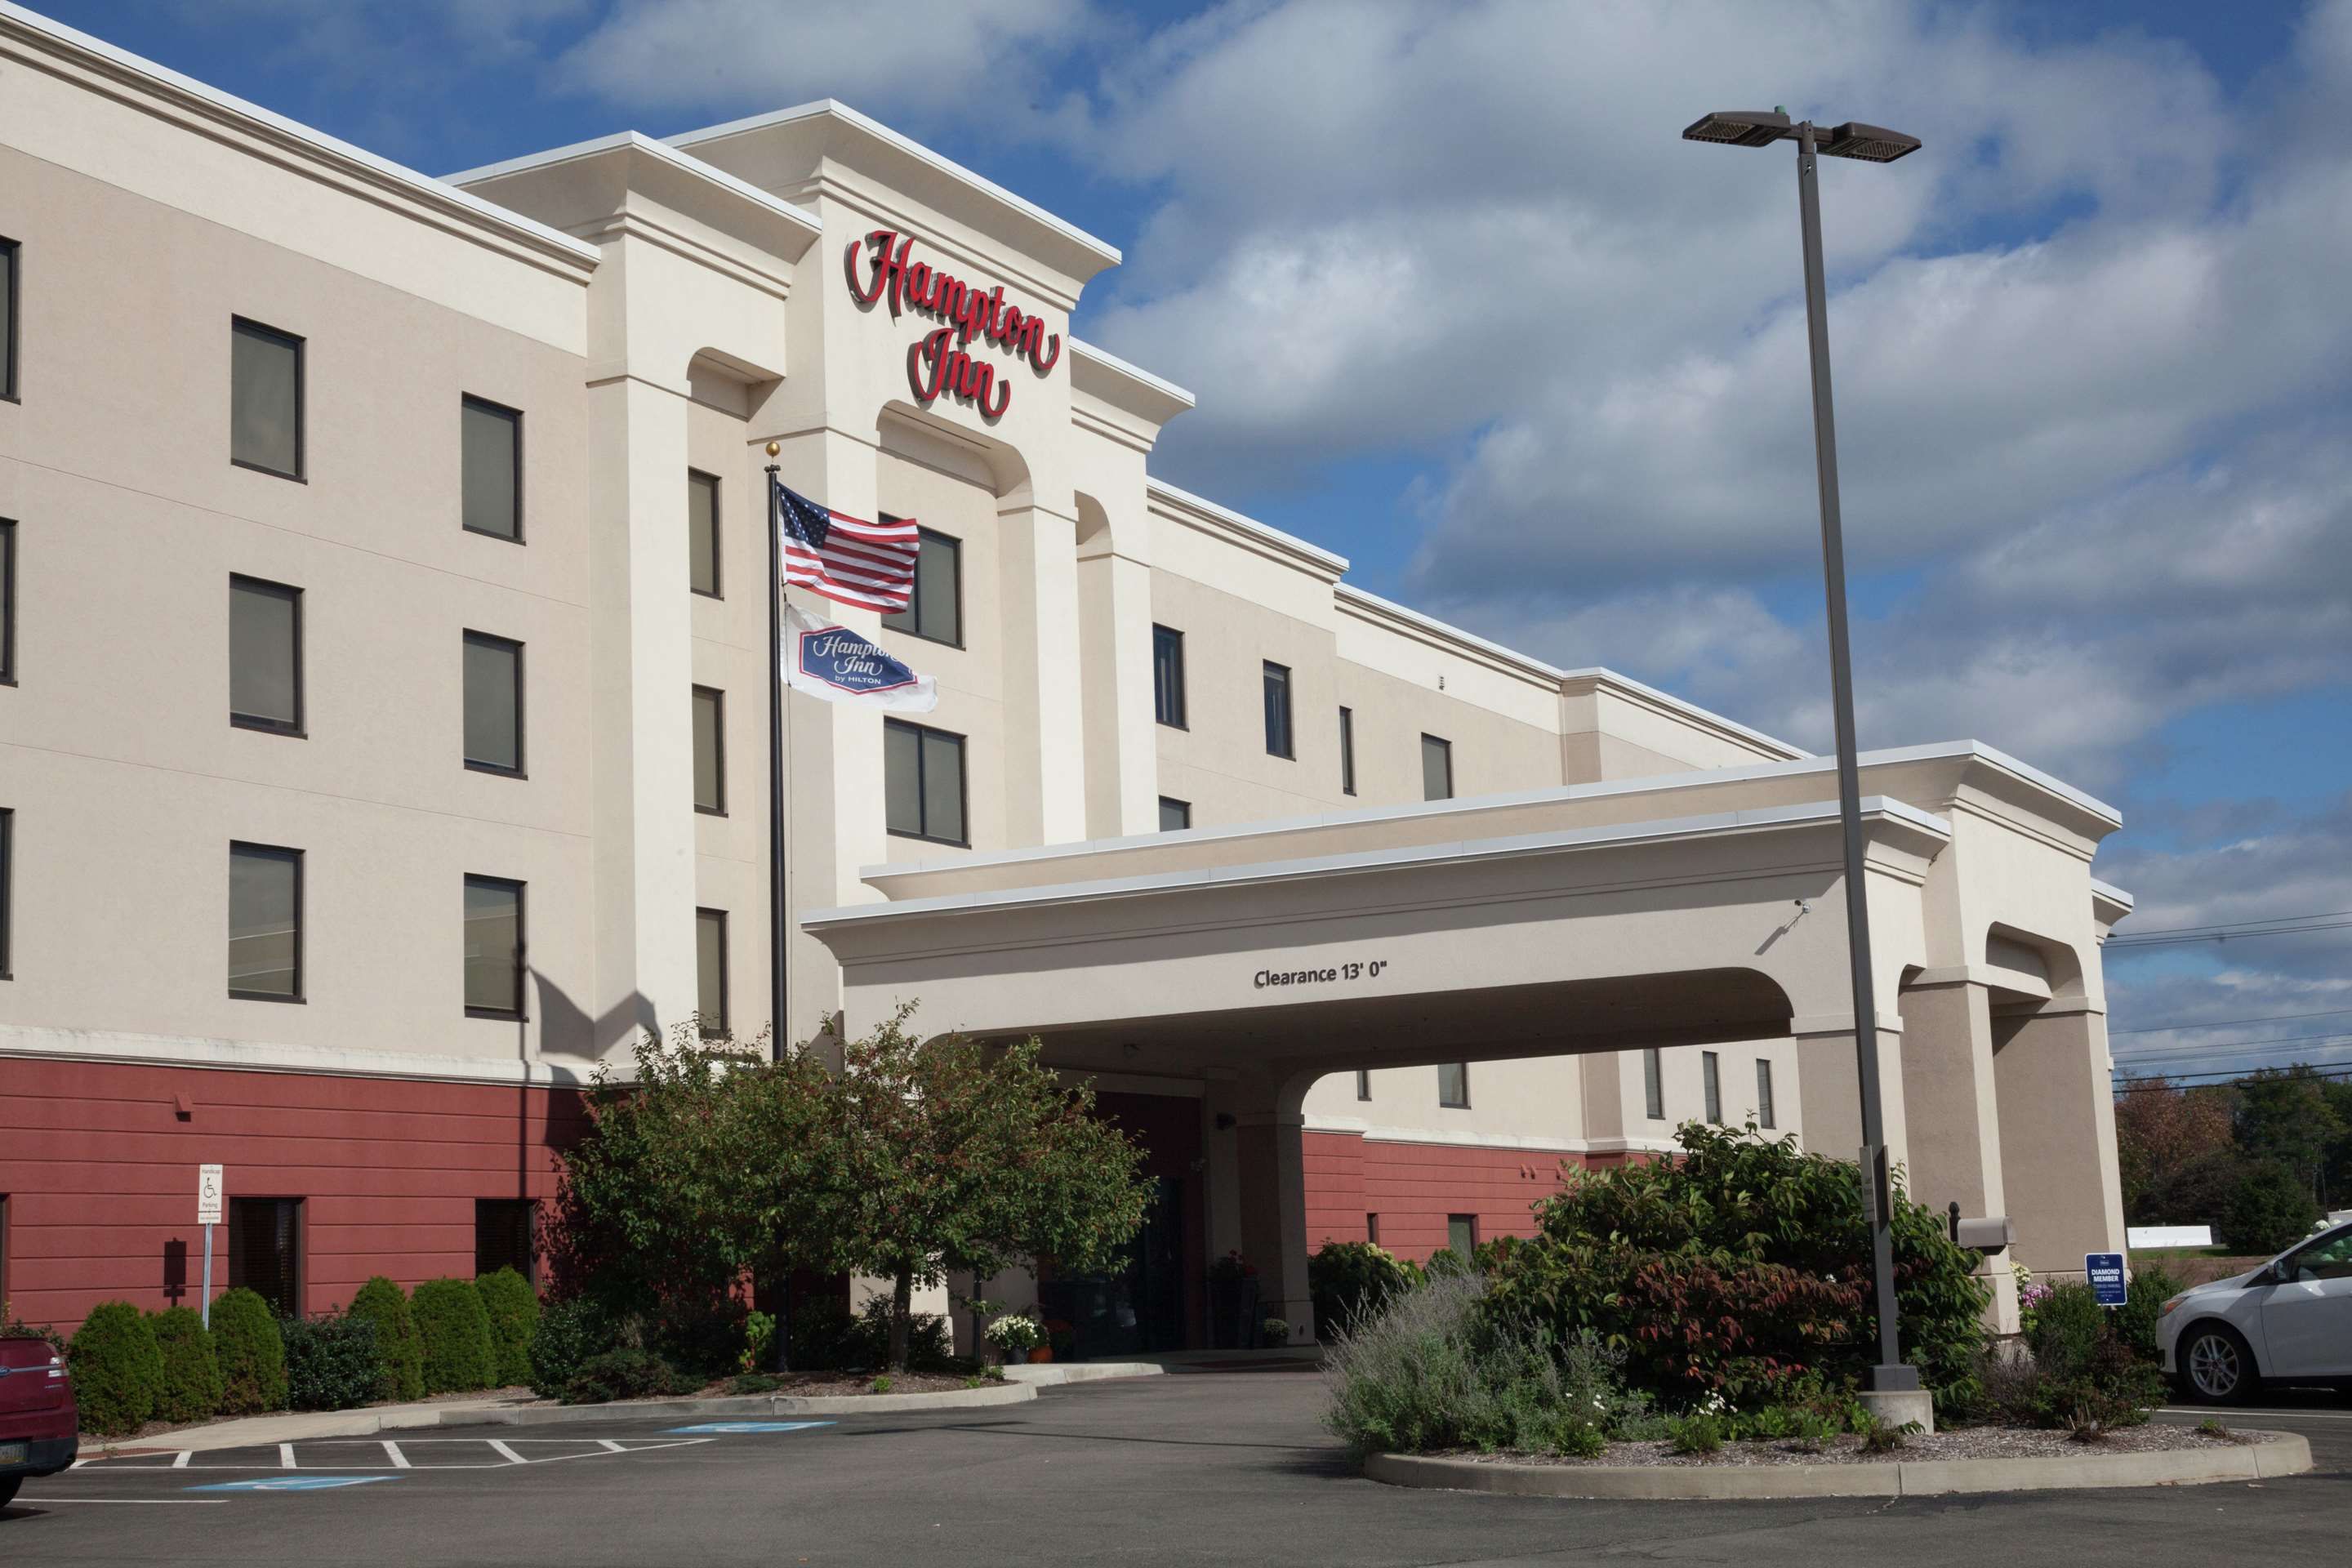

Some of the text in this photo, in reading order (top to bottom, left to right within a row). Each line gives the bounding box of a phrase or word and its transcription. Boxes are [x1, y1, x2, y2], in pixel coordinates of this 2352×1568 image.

[844, 229, 1060, 372] Hampton
[906, 327, 1011, 418] Inn
[833, 656, 883, 676] Inn
[835, 675, 881, 685] by HILTON
[1254, 960, 1388, 989] Clearance 13' 0"
